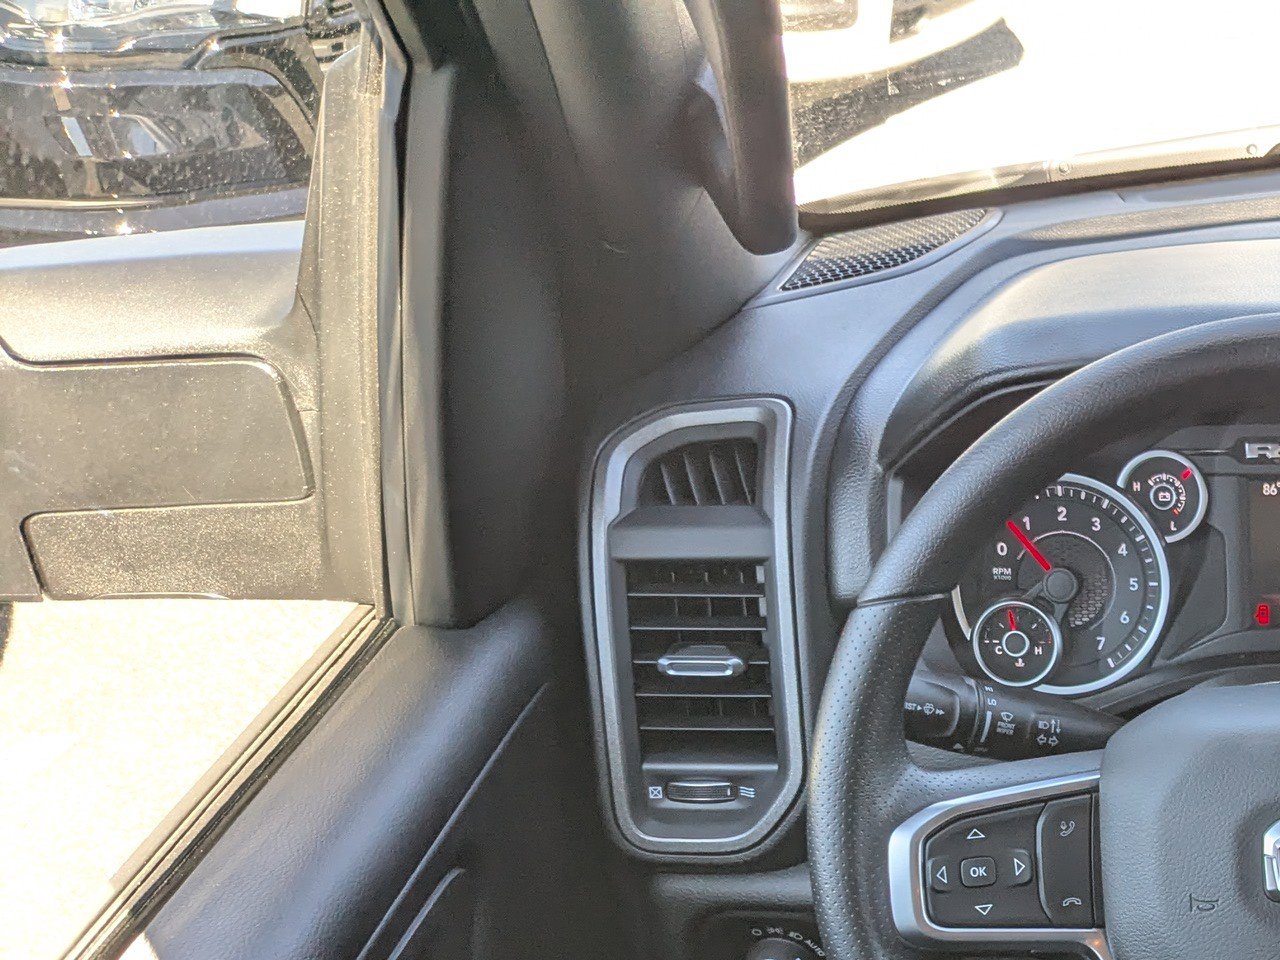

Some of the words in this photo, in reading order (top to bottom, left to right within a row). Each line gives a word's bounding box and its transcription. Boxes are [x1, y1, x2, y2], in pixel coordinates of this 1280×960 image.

[1132, 481, 1141, 492] H
[1057, 506, 1068, 521] 2
[1023, 516, 1031, 531] 1
[1091, 517, 1102, 532] 3
[996, 542, 1008, 556] 0
[1117, 543, 1128, 556] 4
[992, 567, 1012, 575] RPM
[1129, 577, 1139, 591] 5
[1119, 611, 1130, 624] 6
[1096, 637, 1106, 649] 7
[995, 645, 1003, 655] C
[1034, 646, 1043, 655] H
[970, 867, 987, 877] OK
[804, 939, 826, 957] AUTO
